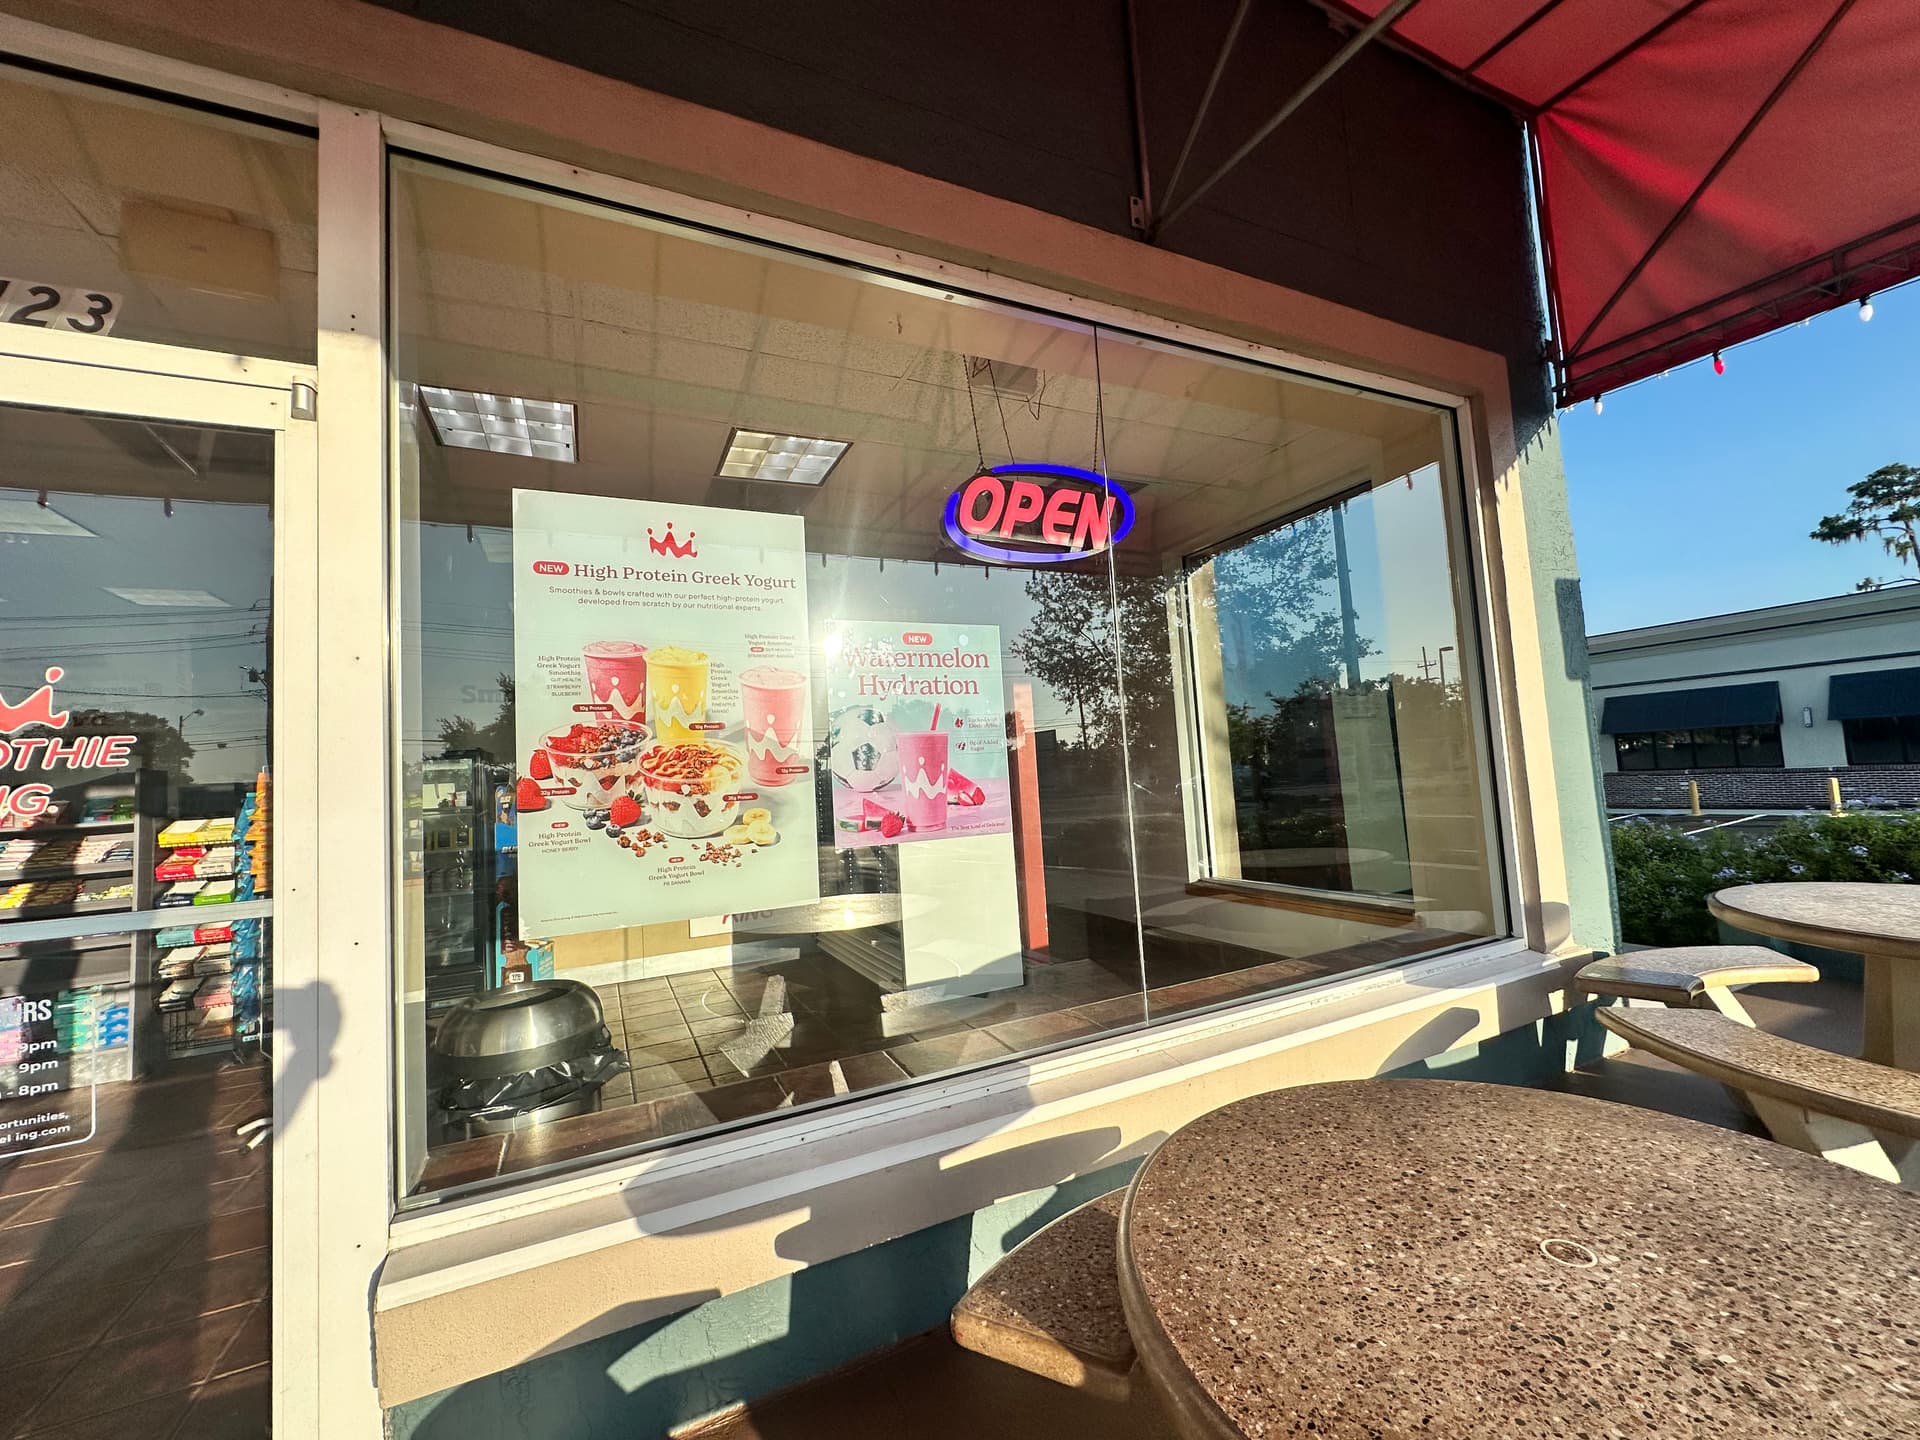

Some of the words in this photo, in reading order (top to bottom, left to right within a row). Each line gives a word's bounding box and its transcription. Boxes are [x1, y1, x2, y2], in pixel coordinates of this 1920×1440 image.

[0, 280, 113, 333] 23
[959, 475, 1117, 553] OPEN
[539, 563, 563, 573] NEW
[574, 564, 618, 581] High
[623, 567, 688, 583] Protein
[692, 571, 741, 586] Greek
[744, 574, 797, 590] Yogurt
[549, 586, 592, 595] Smoothies
[602, 588, 625, 597] bowls
[627, 590, 654, 598] crafted
[657, 591, 672, 599] with
[688, 593, 715, 601] perfect
[578, 598, 620, 608] developed
[622, 599, 640, 607] from
[642, 600, 670, 608] scratch
[672, 601, 681, 609] by
[697, 602, 733, 610] nutritional
[858, 673, 979, 701] Hydration
[20, 1040, 57, 1054] 9pm
[19, 1060, 59, 1074] 9pm
[18, 1082, 59, 1097] 8pm
